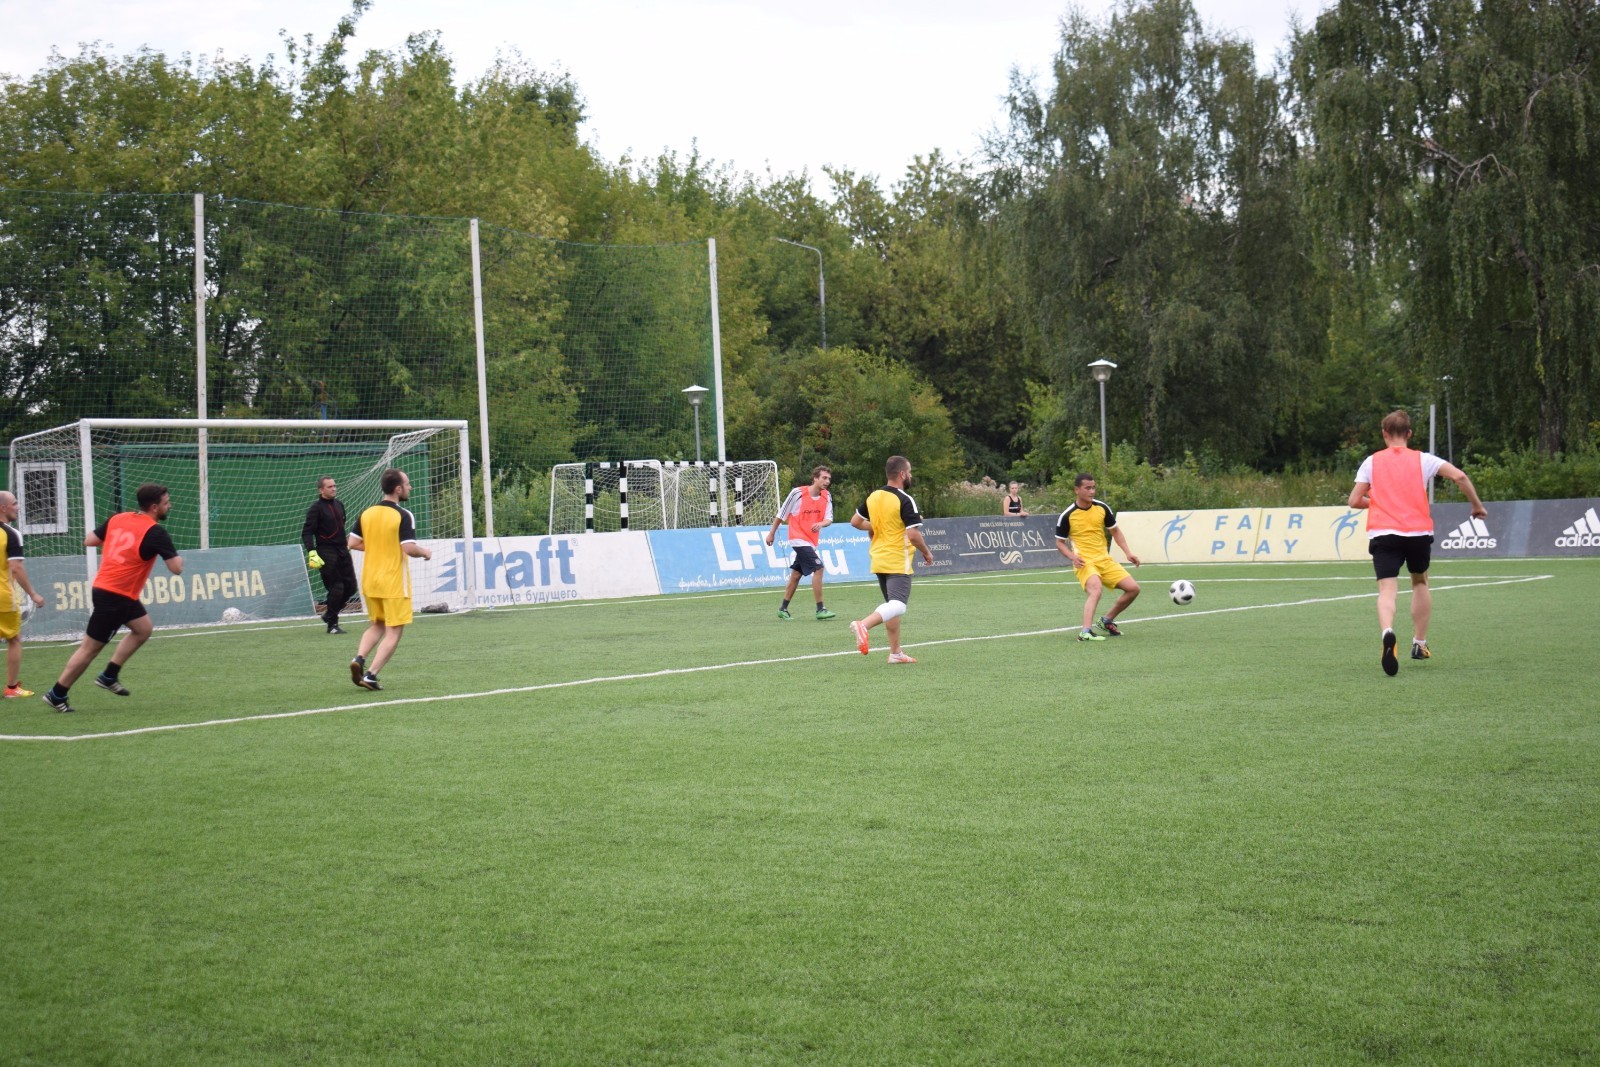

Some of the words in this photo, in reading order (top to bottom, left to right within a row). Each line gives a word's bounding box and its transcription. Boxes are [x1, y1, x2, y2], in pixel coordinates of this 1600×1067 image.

[1214, 513, 1304, 531] FAIR
[108, 528, 135, 564] 12
[966, 530, 1046, 550] MOBILICASA
[1210, 539, 1299, 556] PLAY
[1440, 536, 1497, 550] adidas
[1554, 533, 1600, 548] adida
[455, 537, 577, 590] Traft
[191, 570, 267, 601] АРЕНА
[526, 589, 577, 604] будущего
